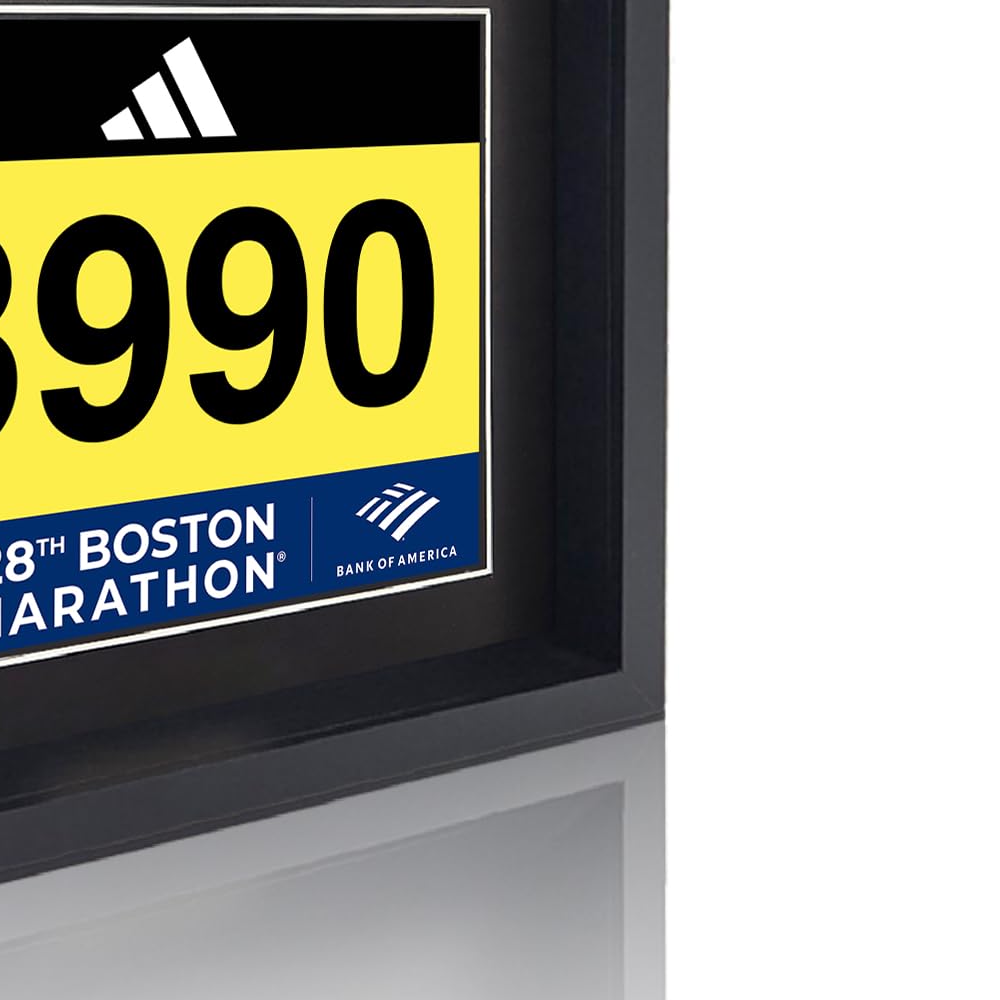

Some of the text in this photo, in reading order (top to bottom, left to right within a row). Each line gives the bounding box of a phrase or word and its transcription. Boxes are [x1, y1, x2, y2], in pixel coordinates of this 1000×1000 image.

[79, 503, 276, 571] BOSTON
[336, 545, 457, 577] BANK OF AMERICA
